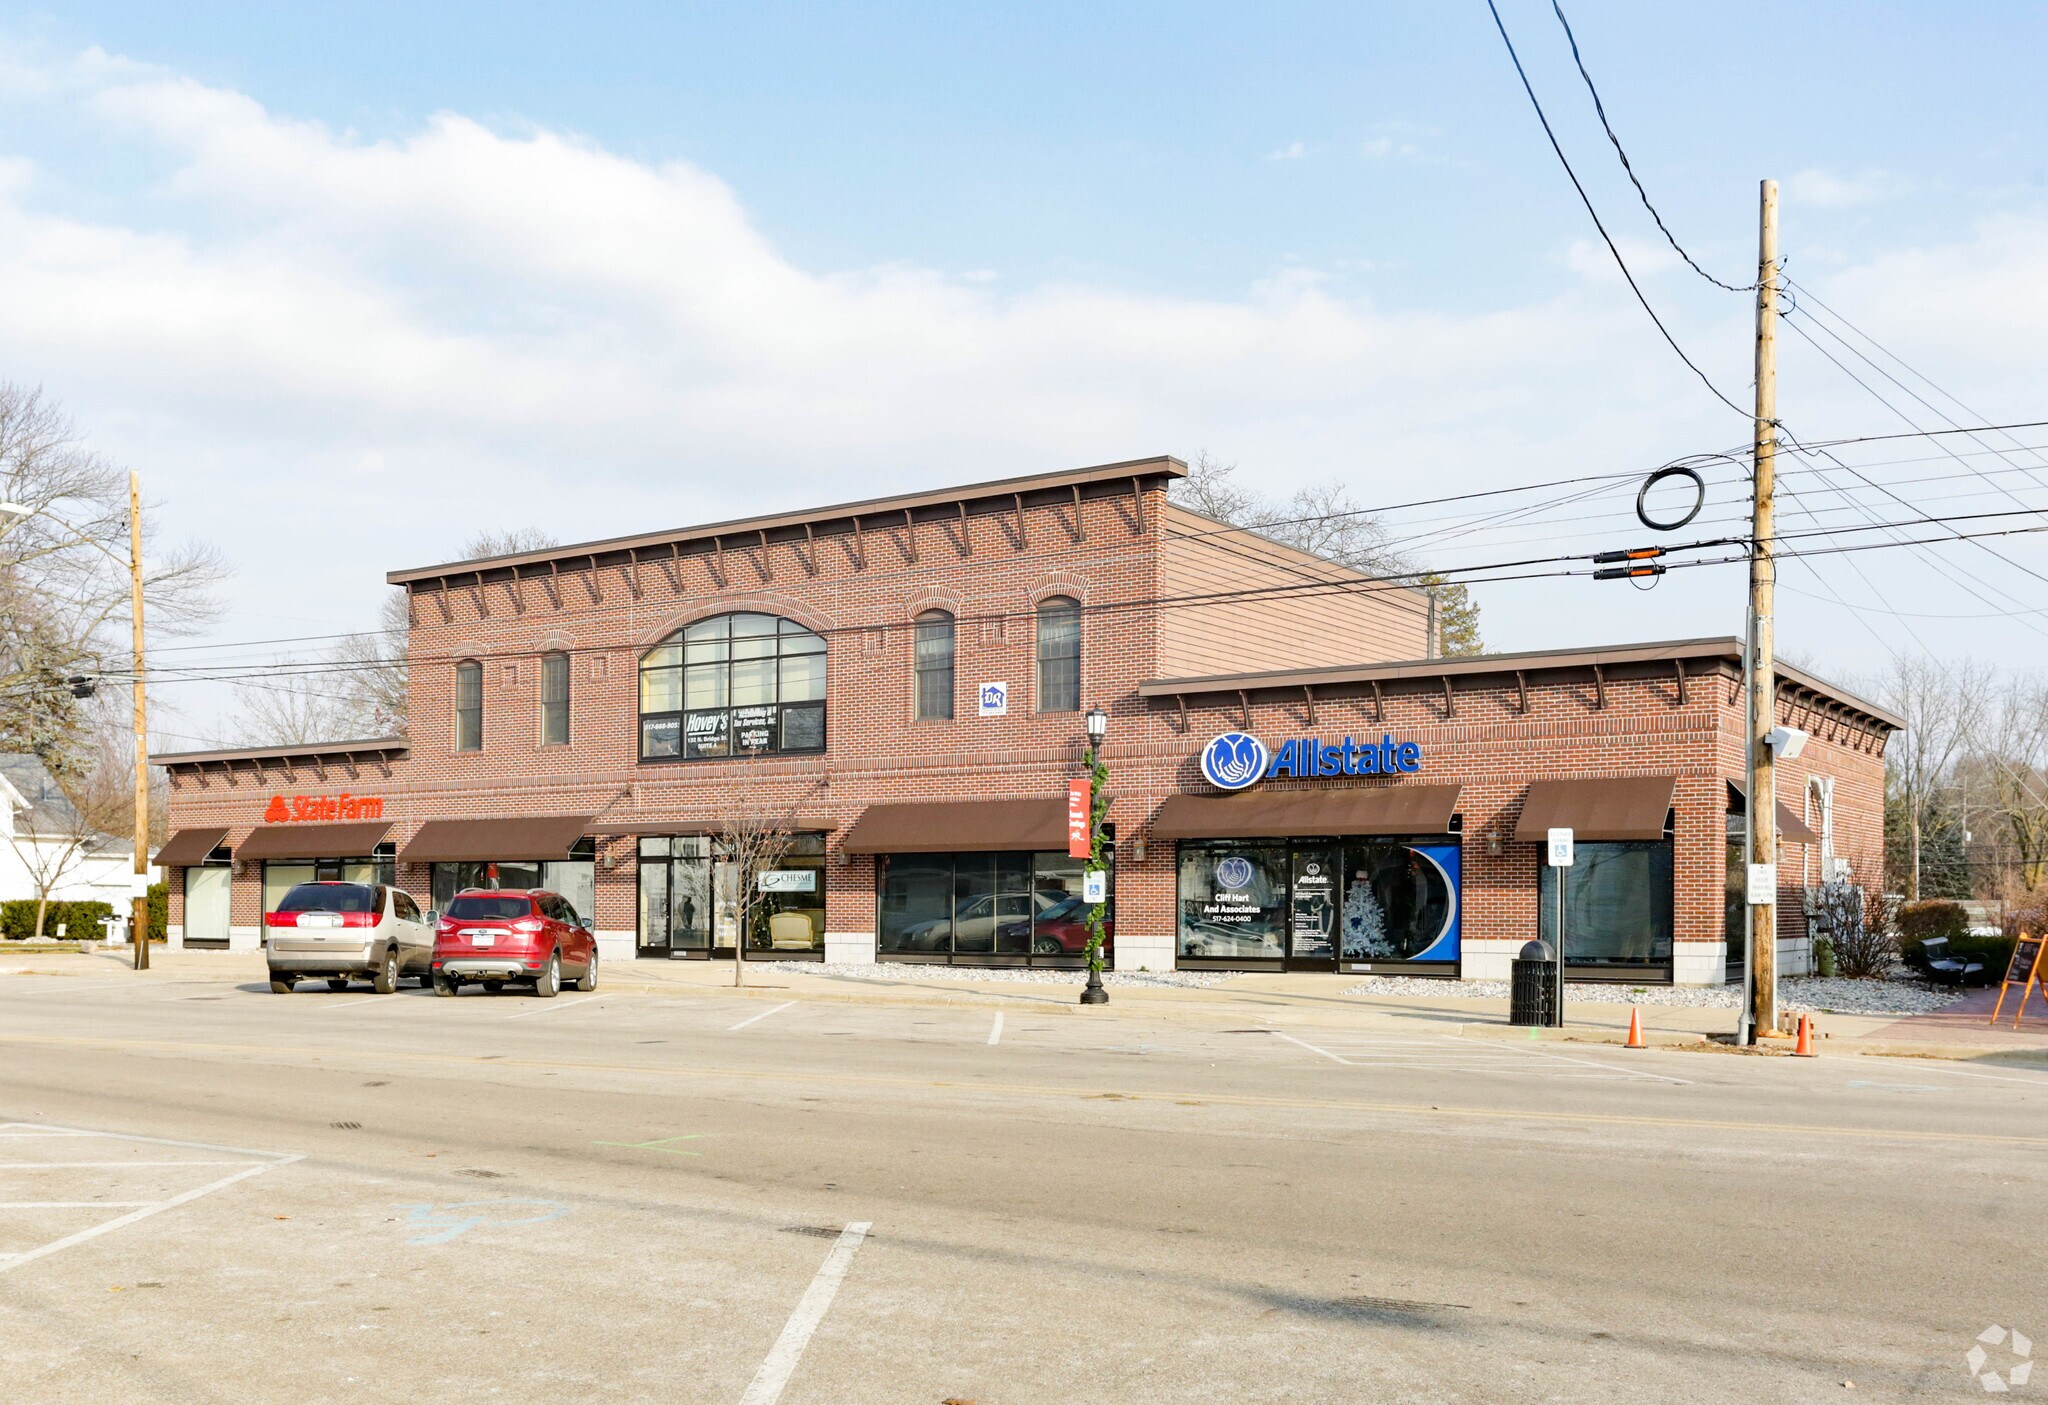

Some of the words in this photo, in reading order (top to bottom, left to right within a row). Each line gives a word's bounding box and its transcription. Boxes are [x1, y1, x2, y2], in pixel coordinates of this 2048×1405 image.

[984, 691, 1002, 707] DR
[687, 712, 729, 735] Hovey's
[1265, 734, 1422, 778] Allstate
[780, 873, 812, 882] CHESME
[1298, 875, 1328, 884] Allstate
[1215, 893, 1232, 902] Cliff
[1232, 893, 1249, 902] Hart
[1203, 905, 1220, 913] And
[1220, 904, 1261, 914] Associates
